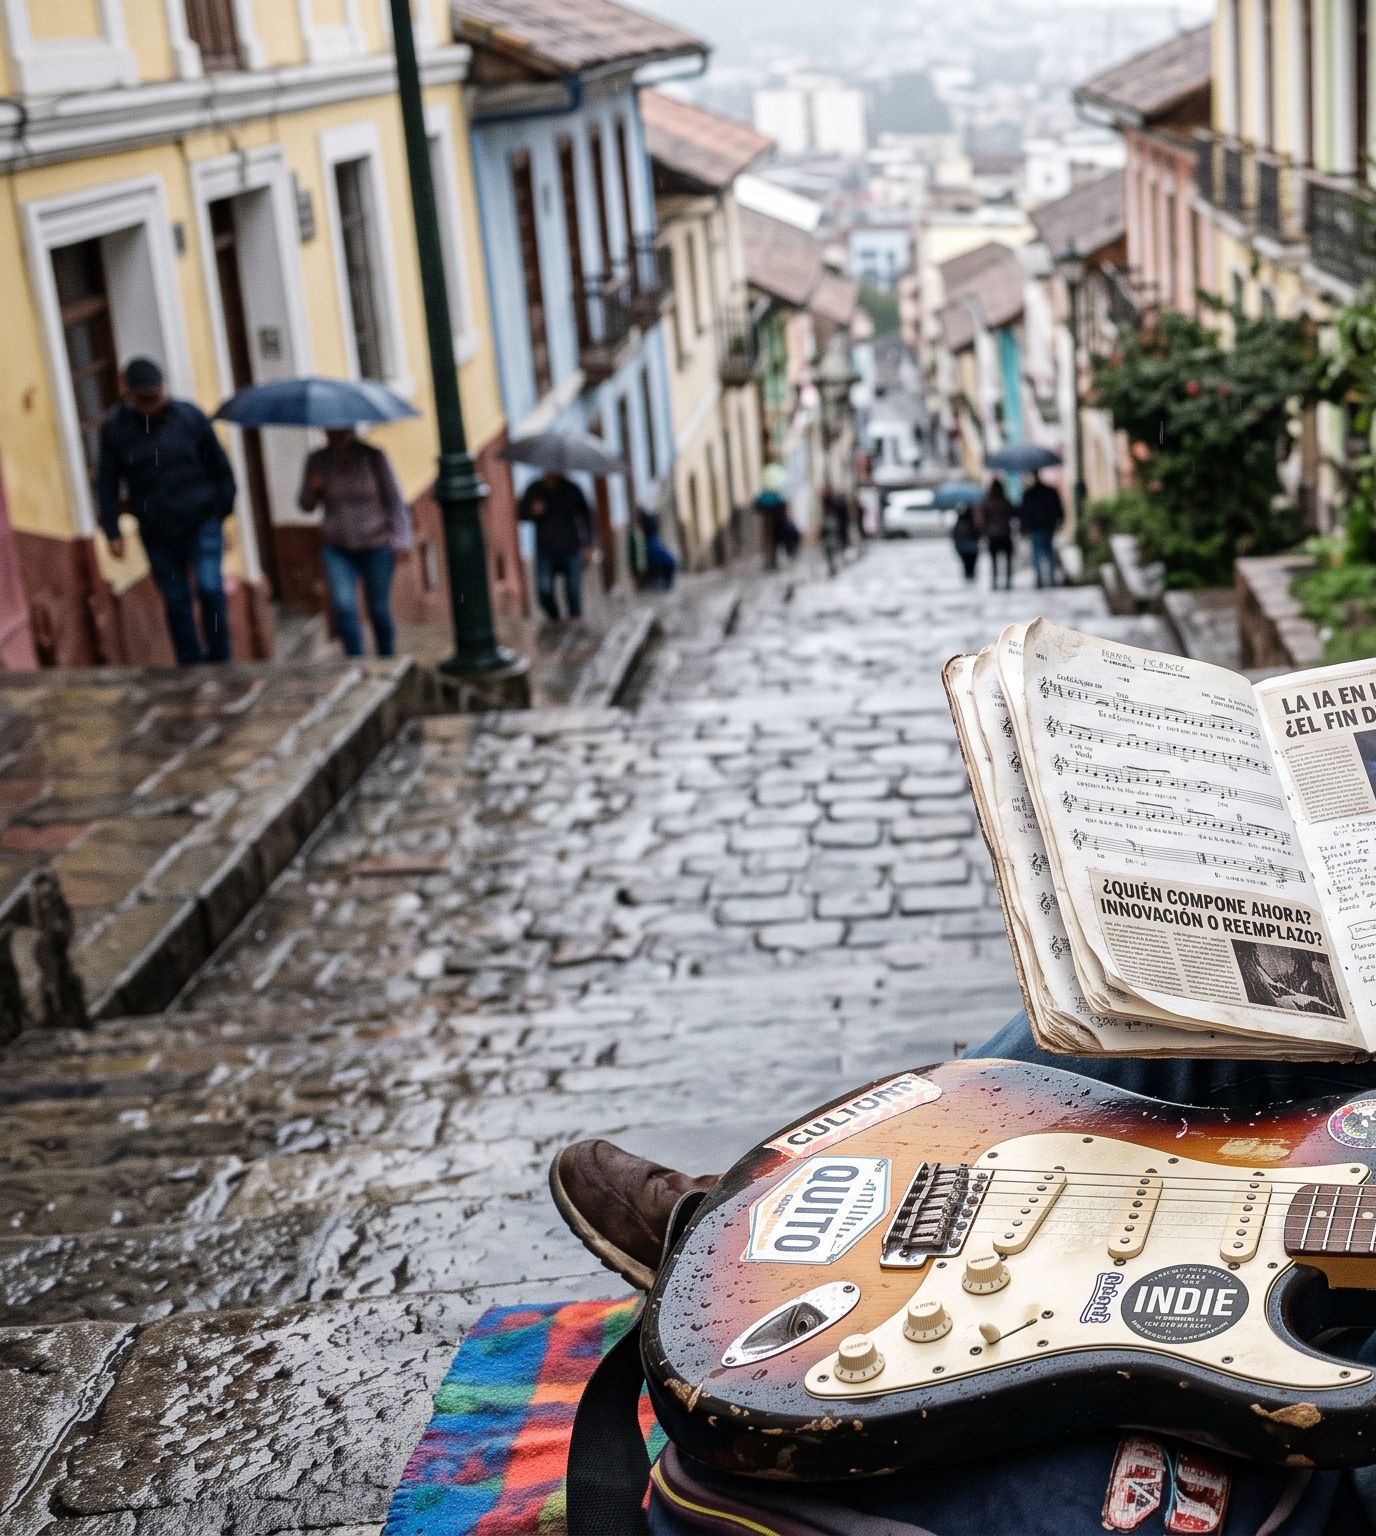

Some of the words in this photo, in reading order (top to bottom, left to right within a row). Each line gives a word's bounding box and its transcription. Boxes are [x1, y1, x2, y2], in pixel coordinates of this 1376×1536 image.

[1282, 695, 1310, 715] LA
[1312, 690, 1336, 709] IA
[1338, 685, 1366, 704] EN
[1286, 716, 1321, 737] ¿EL
[1323, 709, 1358, 729] FIN
[1103, 879, 1162, 903] ¿QUIÉN
[1167, 887, 1247, 915] COMPONE
[1251, 901, 1311, 925] AHORA?
[1101, 898, 1204, 928] INNOVACIÓN
[1207, 914, 1219, 931] O
[1222, 917, 1322, 946] REEMPLAZO?
[774, 1165, 859, 1252] QUITO
[1133, 1286, 1238, 1316] INDIE
